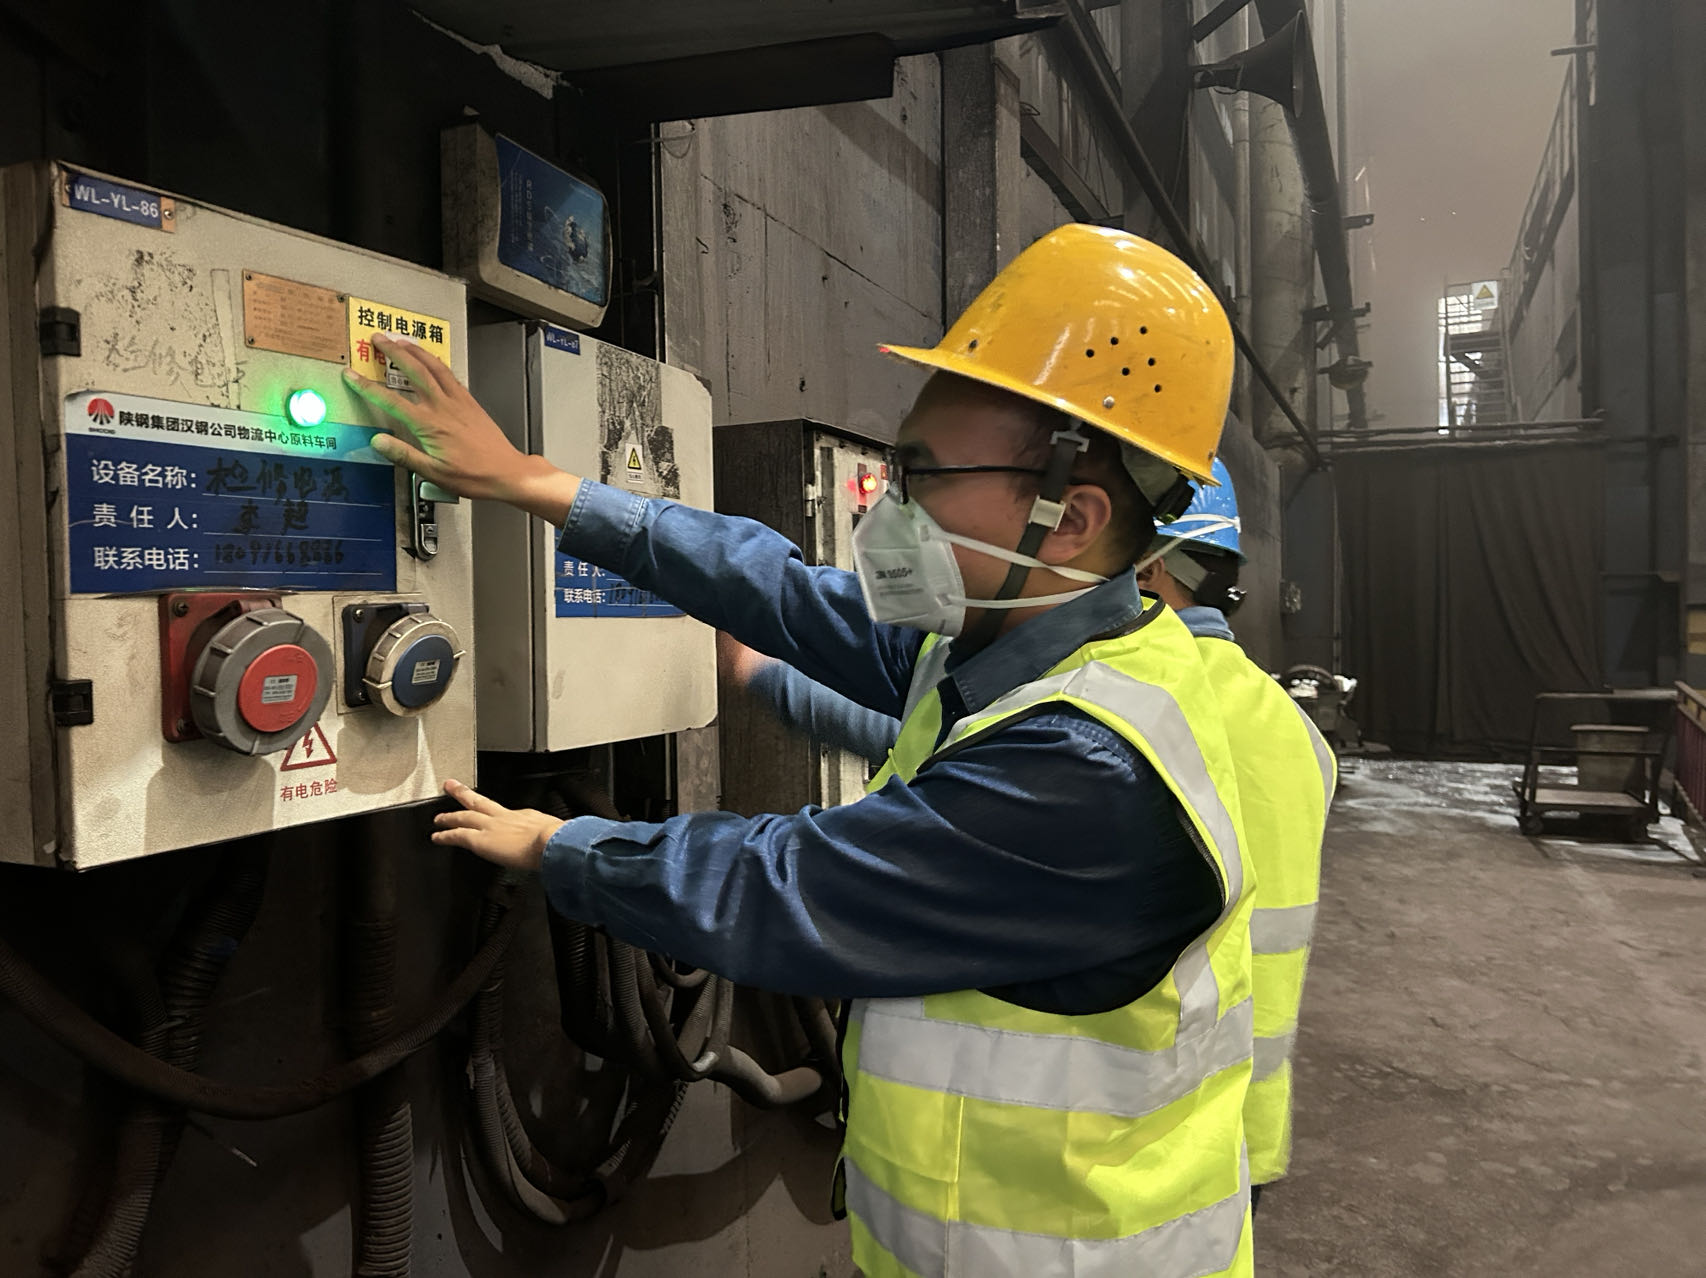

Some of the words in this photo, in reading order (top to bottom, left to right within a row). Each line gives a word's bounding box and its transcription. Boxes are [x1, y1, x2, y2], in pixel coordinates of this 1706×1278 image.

[74, 183, 159, 218] WL-YL-86
[357, 306, 443, 344] 控制电源箱
[118, 410, 337, 450] 陕钢集团汉钢公司物流中心原料车间
[91, 459, 197, 489] 设备名称：
[93, 546, 199, 570] 联系电话：
[280, 778, 338, 802] 有电危险
